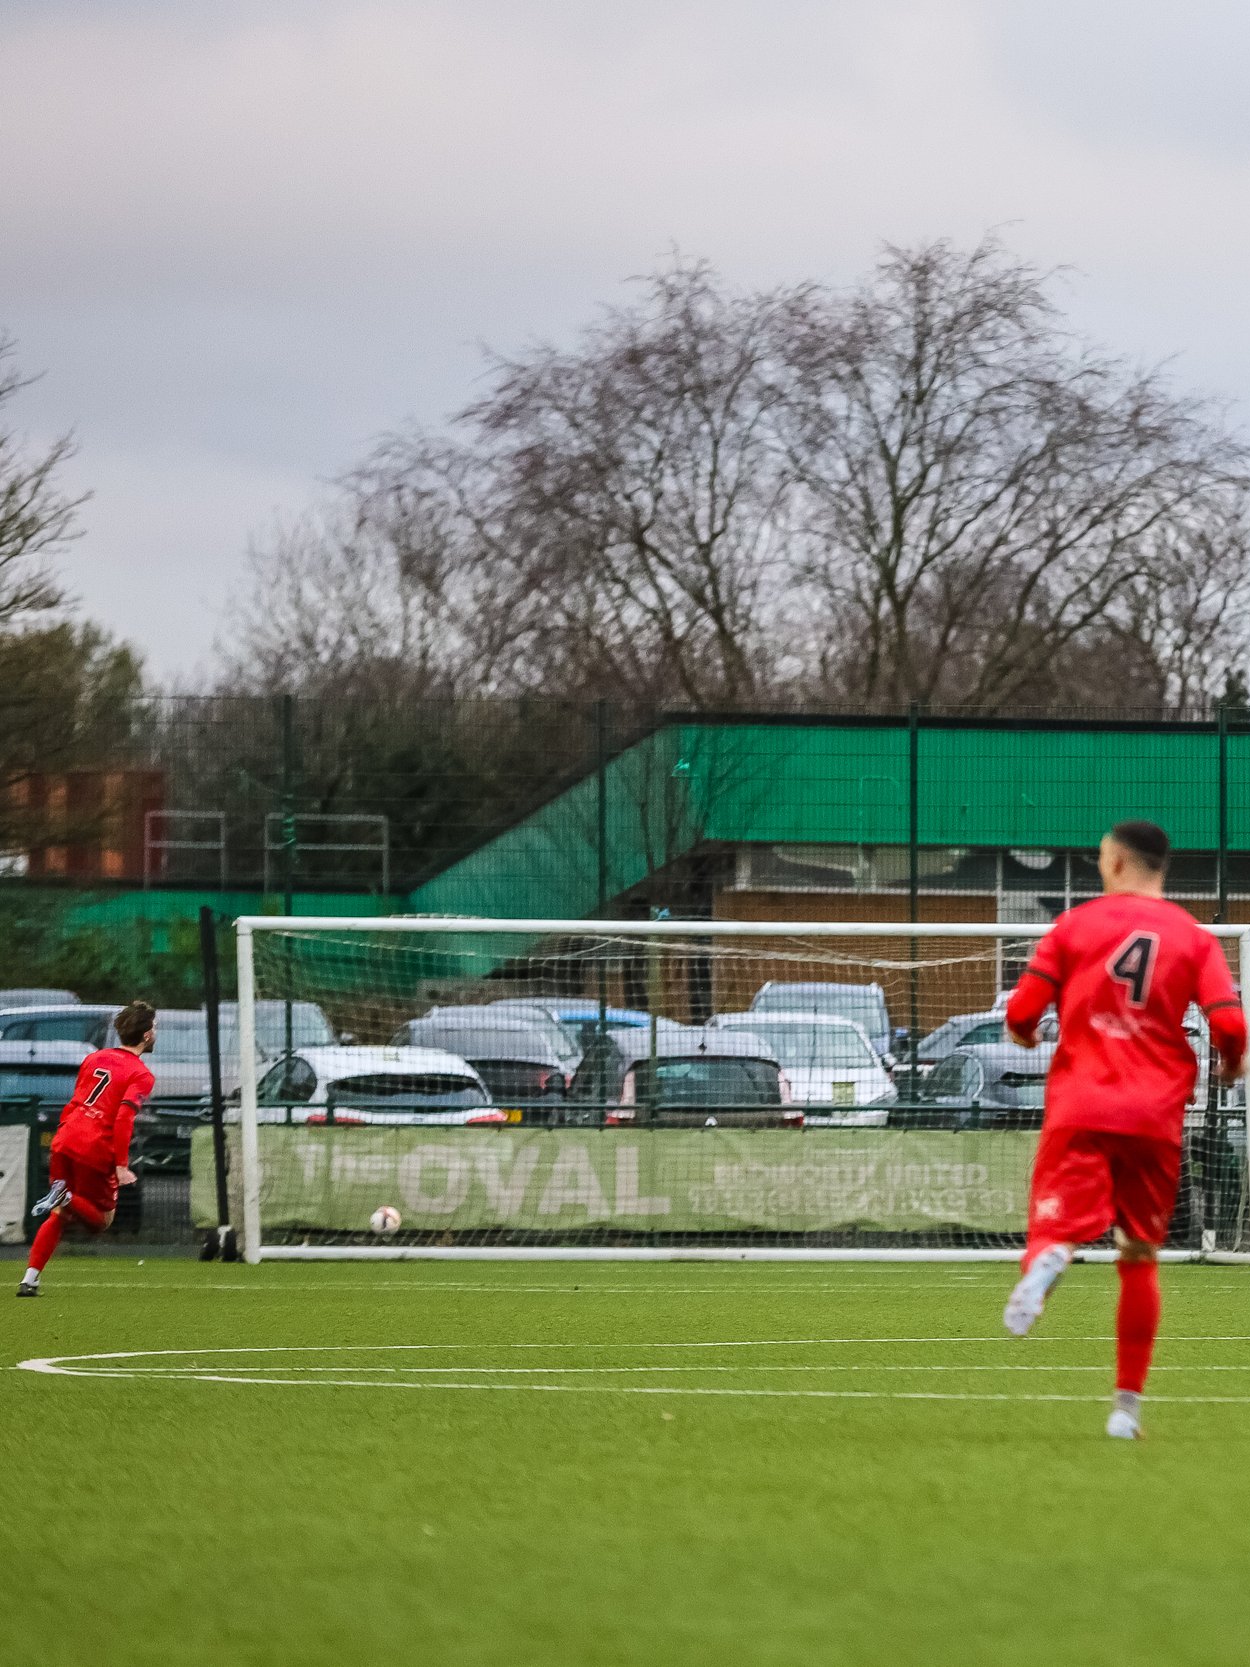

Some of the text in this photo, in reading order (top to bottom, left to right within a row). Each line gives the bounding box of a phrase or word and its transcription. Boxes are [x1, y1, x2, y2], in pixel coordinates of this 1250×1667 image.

[1105, 929, 1160, 1010] 4
[83, 1067, 112, 1106] 7
[399, 1144, 671, 1217] OVAL
